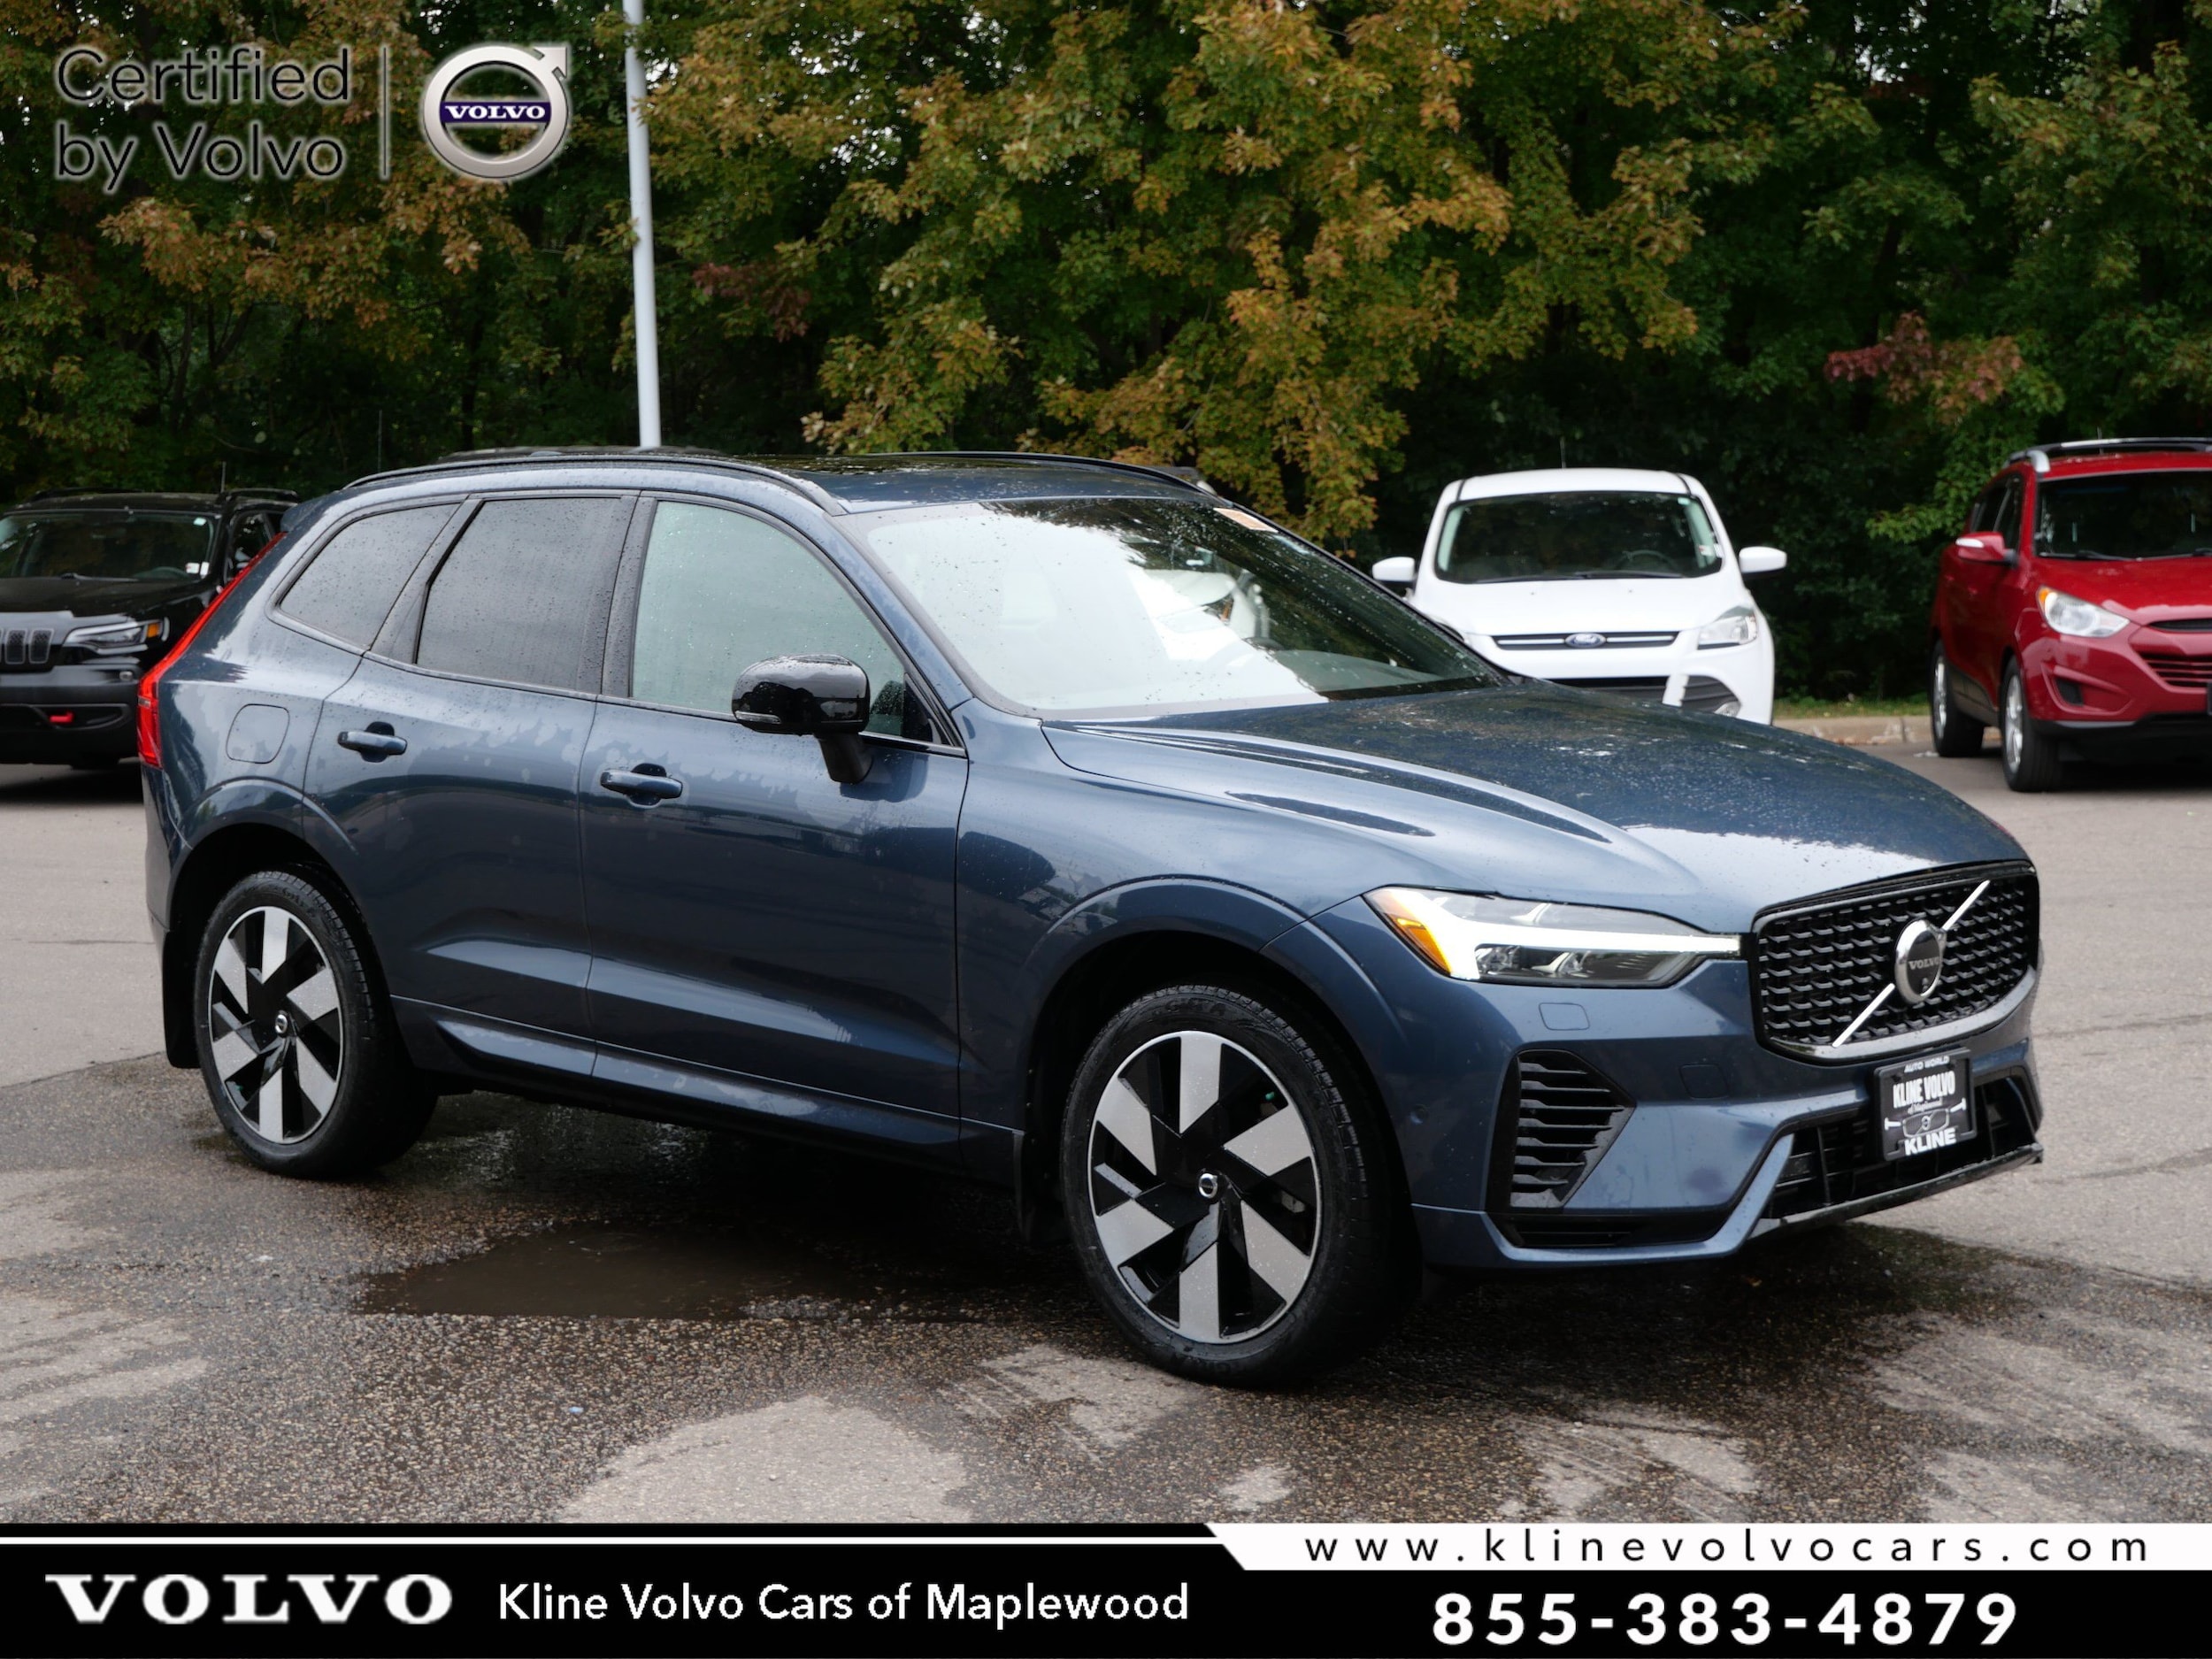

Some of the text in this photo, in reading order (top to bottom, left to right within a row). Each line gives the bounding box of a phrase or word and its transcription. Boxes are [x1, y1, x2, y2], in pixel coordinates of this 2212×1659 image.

[1909, 956, 1940, 971] VOLVO
[1904, 1056, 1950, 1073] AUTO WORLD
[1893, 1078, 1924, 1109] KLINE
[1924, 1071, 1955, 1101] VOLVO
[1904, 1127, 1957, 1156] KLINE
